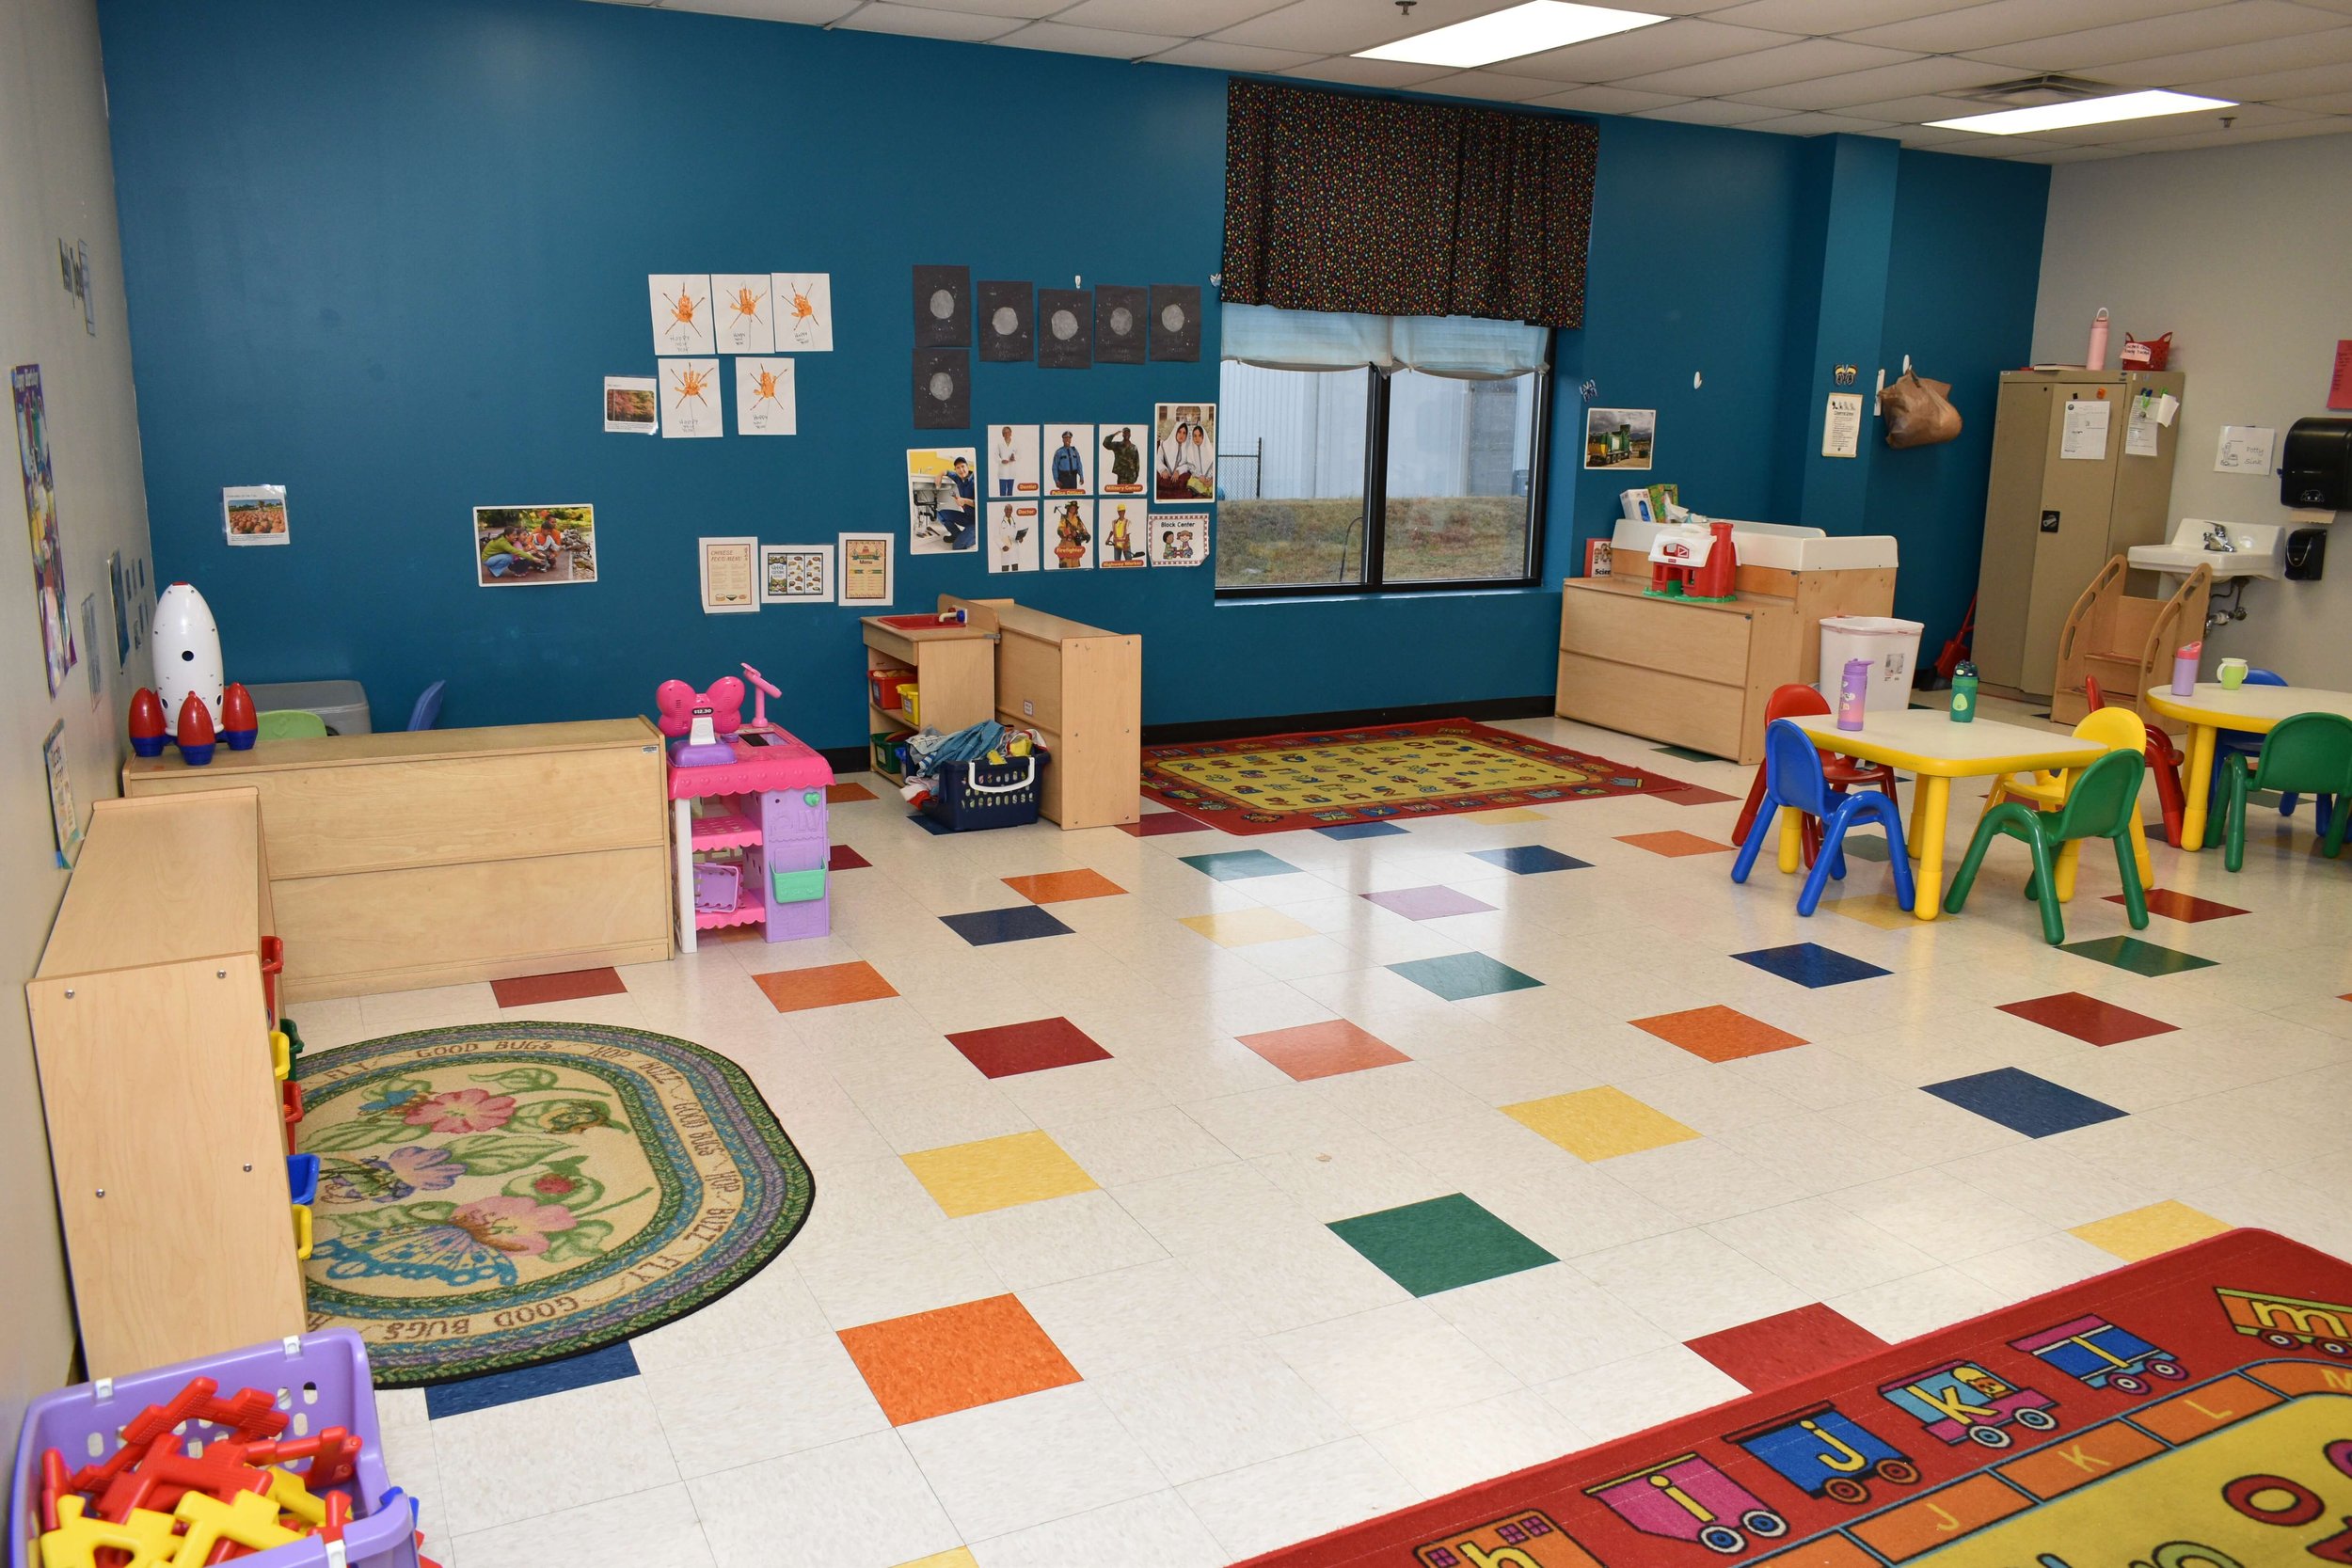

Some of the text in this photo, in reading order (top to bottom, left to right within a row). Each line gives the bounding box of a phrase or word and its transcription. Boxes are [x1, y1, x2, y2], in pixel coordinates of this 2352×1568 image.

[415, 1040, 554, 1058] GOOD BUGS
[588, 1046, 685, 1085] HOP BUZZ
[324, 1062, 370, 1080] FLY
[673, 1101, 725, 1157] GOOD BUGS
[683, 1170, 741, 1243] HOP BUZZ
[628, 1255, 683, 1283] FLY
[382, 1295, 580, 1340] GOOD BUGS
[1927, 1503, 1960, 1531] J
[2058, 1445, 2112, 1473] K
[2184, 1399, 2233, 1419] L
